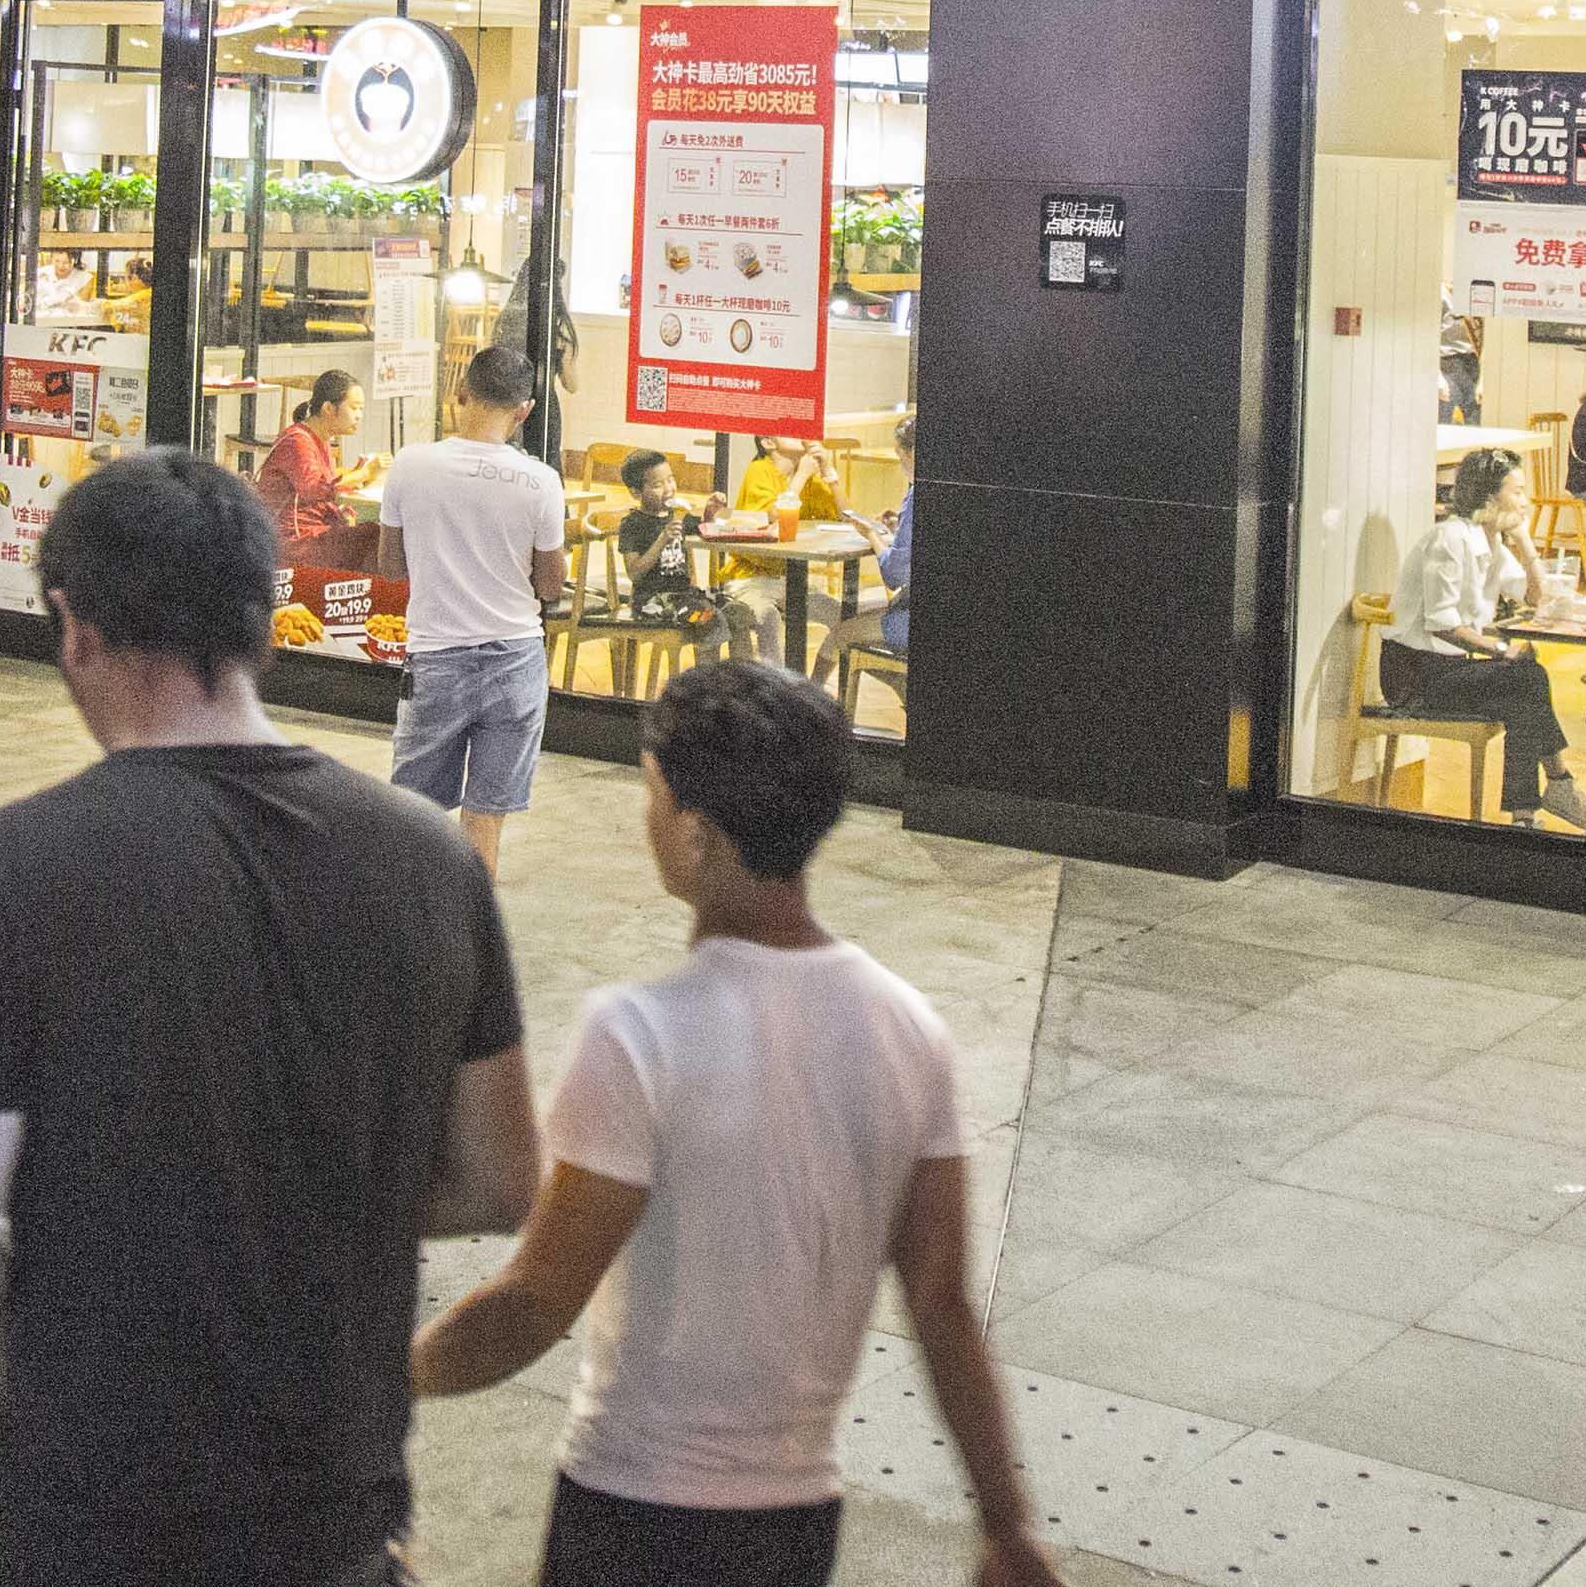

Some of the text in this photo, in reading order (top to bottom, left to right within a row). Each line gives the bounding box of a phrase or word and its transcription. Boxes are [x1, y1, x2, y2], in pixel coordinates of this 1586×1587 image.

[650, 32, 688, 49] 大神会员
[652, 62, 817, 86] 大神卡最高劲省3085元!
[652, 88, 817, 116] 会员花38元享90天权益
[680, 133, 744, 149] 每天免2次外送费
[1478, 111, 1568, 159] 10元
[1047, 200, 1114, 219] 手机扫一扫
[1044, 217, 1124, 237] 点餐不排队!
[674, 292, 791, 313] 每天1杯任一大杯现磨咖啡10元
[468, 458, 541, 490] Jeans
[325, 598, 372, 620] 20块19.9
